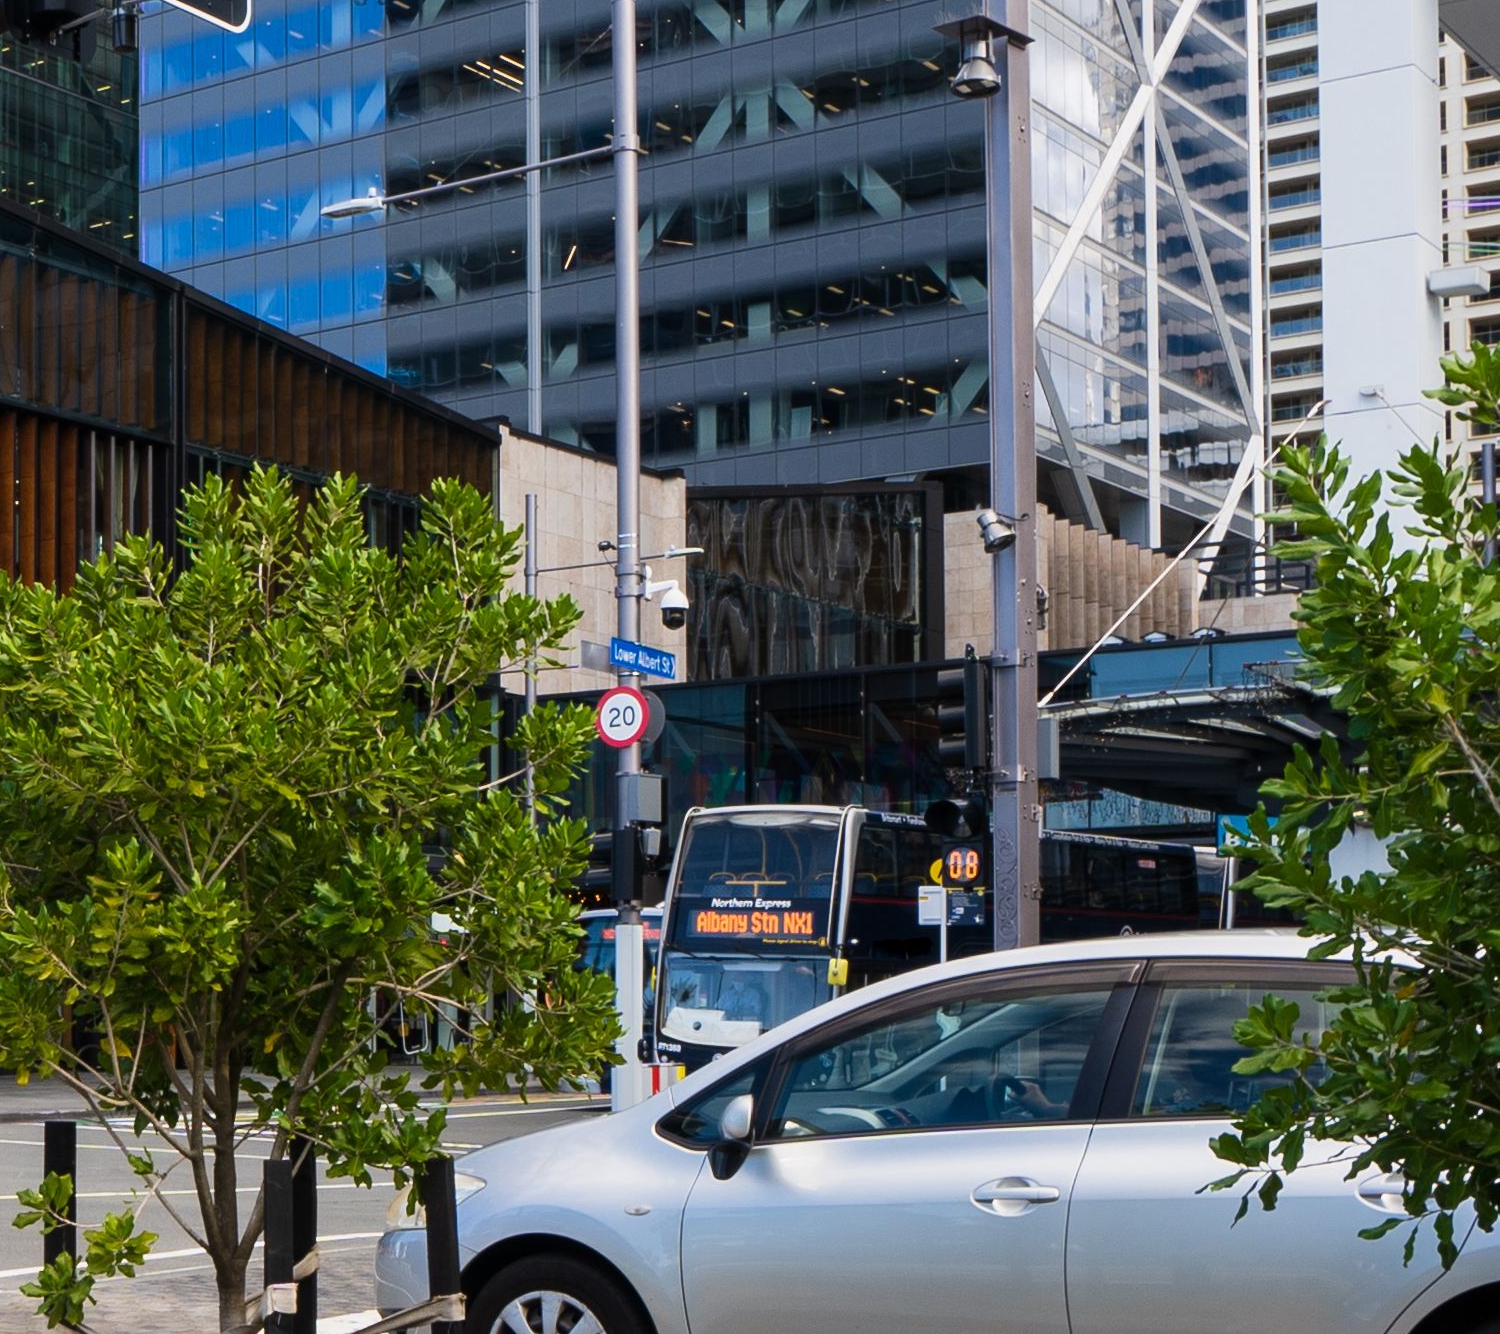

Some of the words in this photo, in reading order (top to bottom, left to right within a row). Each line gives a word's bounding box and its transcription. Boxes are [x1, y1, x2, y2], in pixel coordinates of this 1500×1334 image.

[614, 642, 637, 665] Lower
[638, 650, 661, 673] Albert
[661, 656, 671, 674] St
[608, 705, 636, 728] 20
[949, 850, 979, 879] 08
[710, 897, 753, 909] Northern
[755, 897, 792, 910] Express
[696, 911, 748, 934] Albany
[751, 911, 780, 935] Stn
[783, 911, 813, 935] NX1
